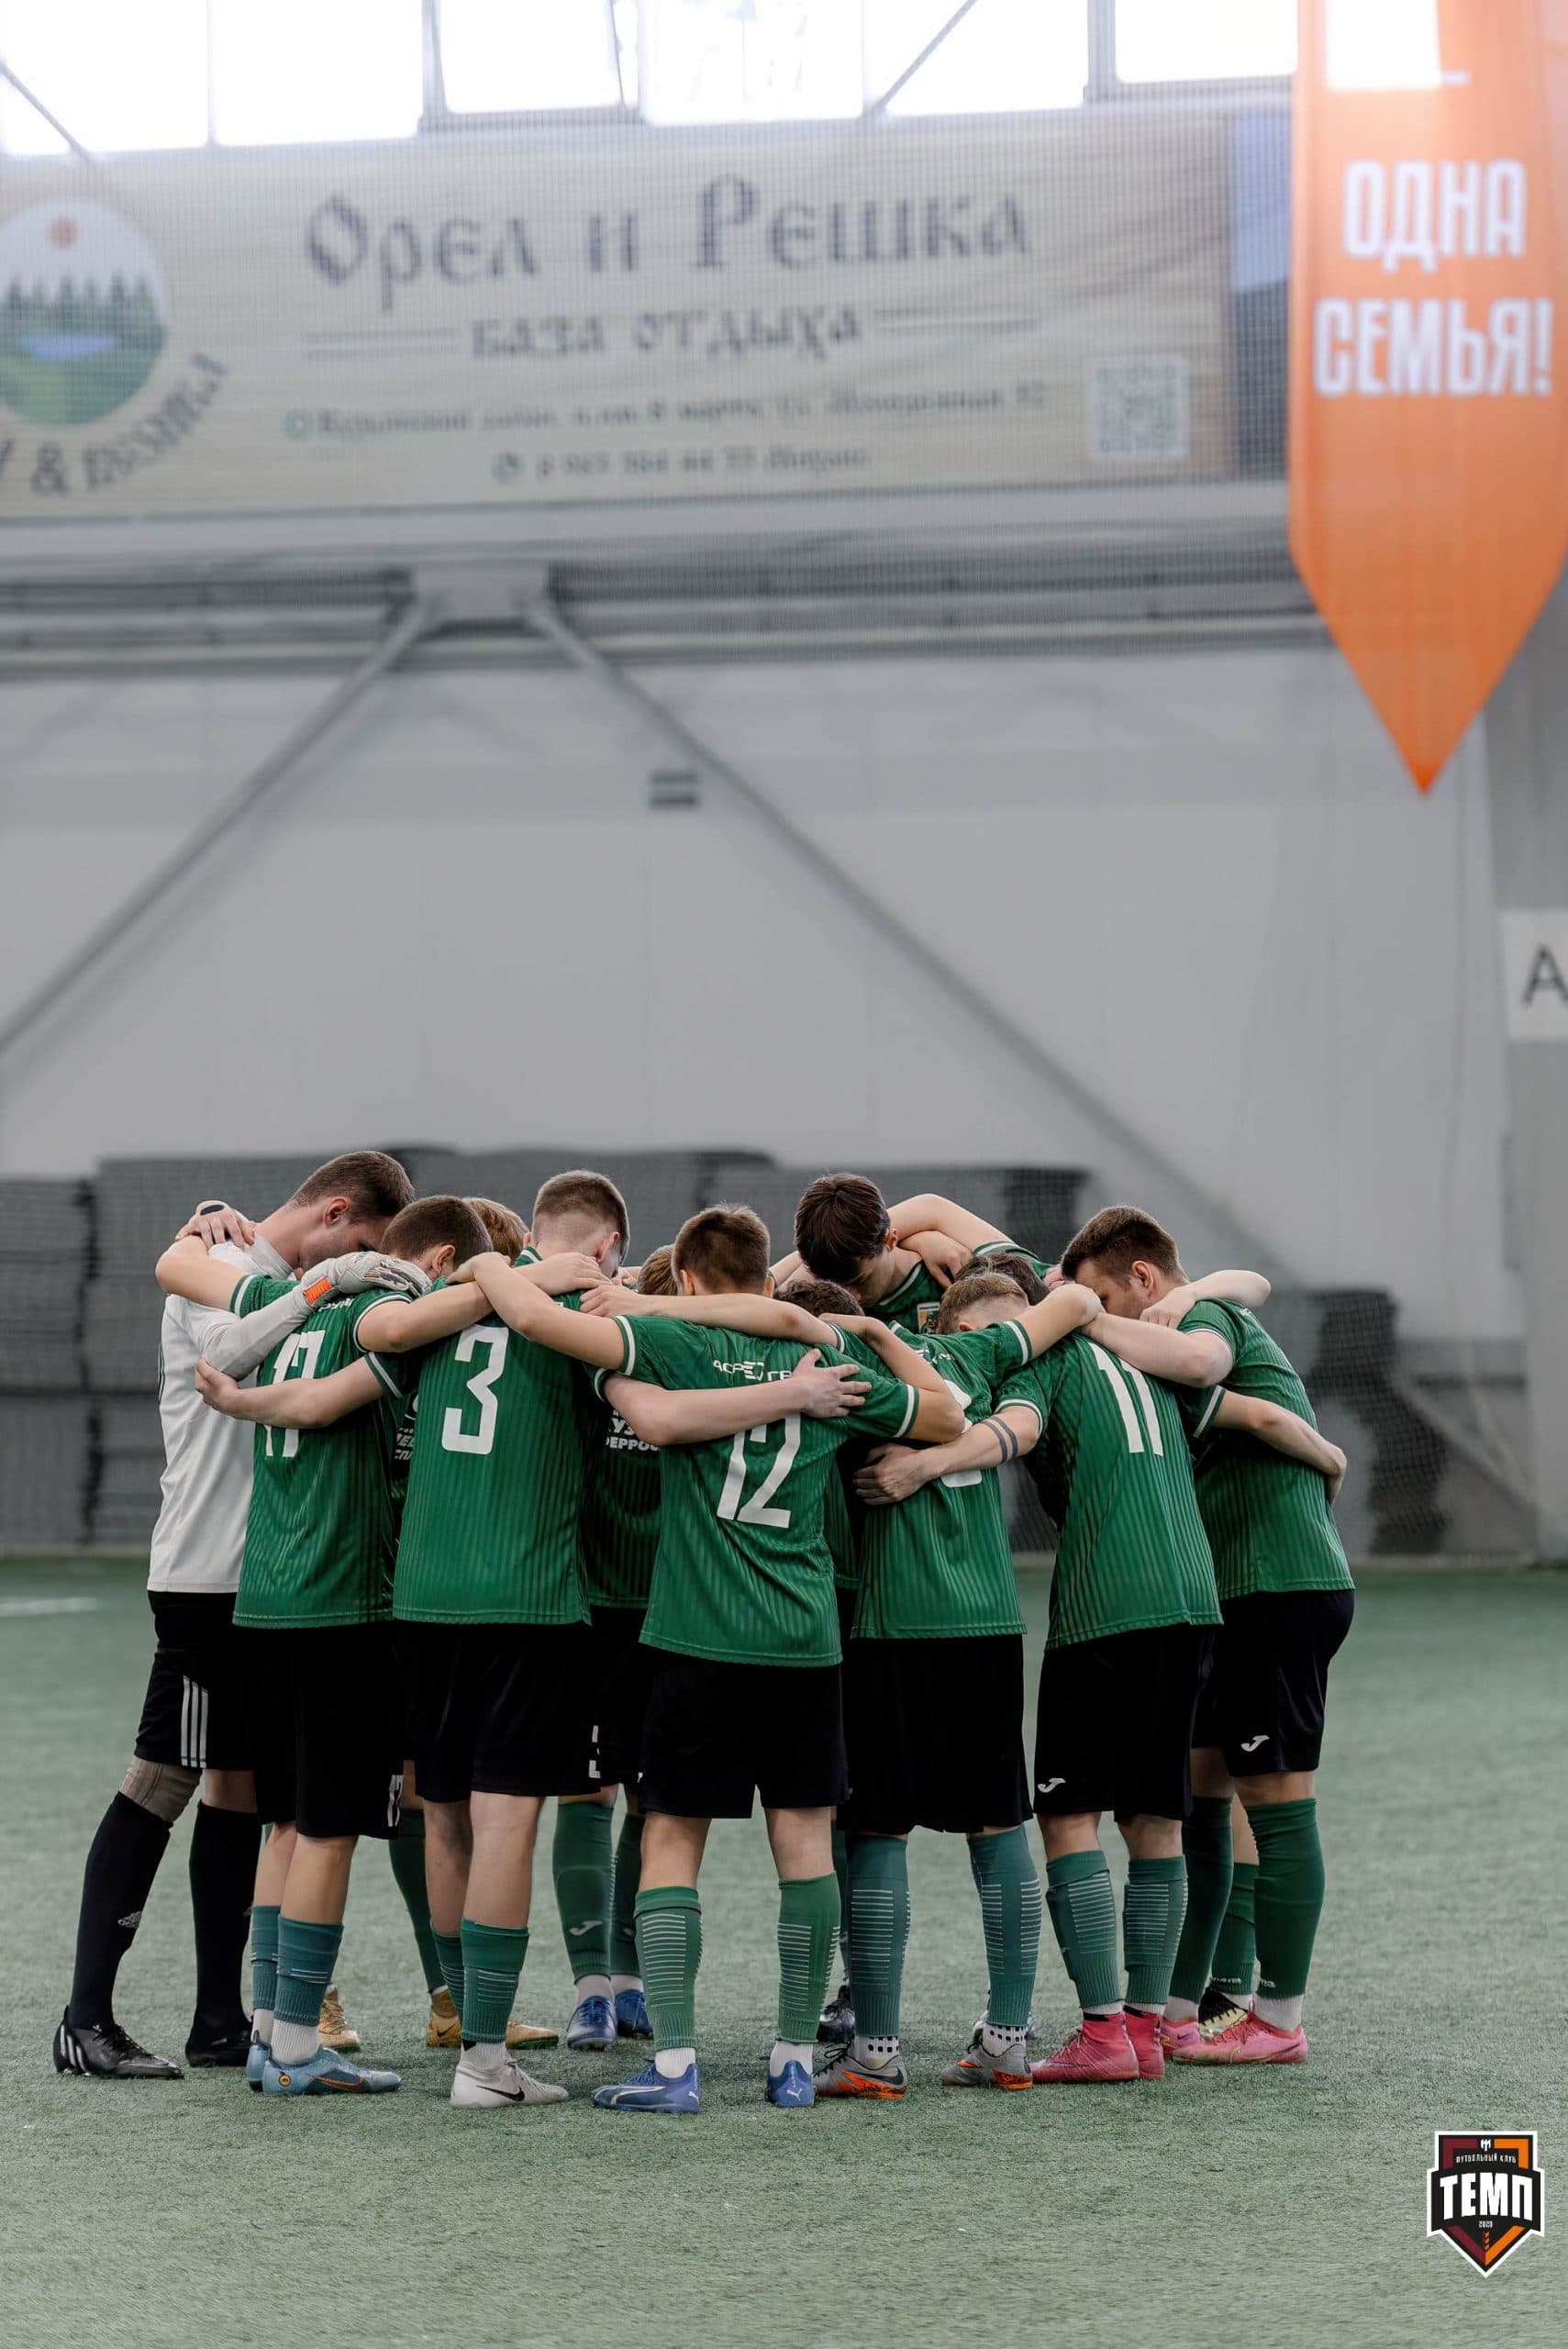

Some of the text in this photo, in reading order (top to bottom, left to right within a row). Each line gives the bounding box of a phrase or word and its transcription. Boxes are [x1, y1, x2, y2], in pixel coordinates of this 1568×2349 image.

[586, 211, 640, 274] и
[691, 173, 1029, 272] Решка
[1341, 158, 1527, 274] ОДНА
[1313, 298, 1554, 397] СЕМЬЯ!
[441, 1327, 510, 1456] 3
[1086, 1341, 1164, 1456] 11
[716, 1411, 802, 1529] 12
